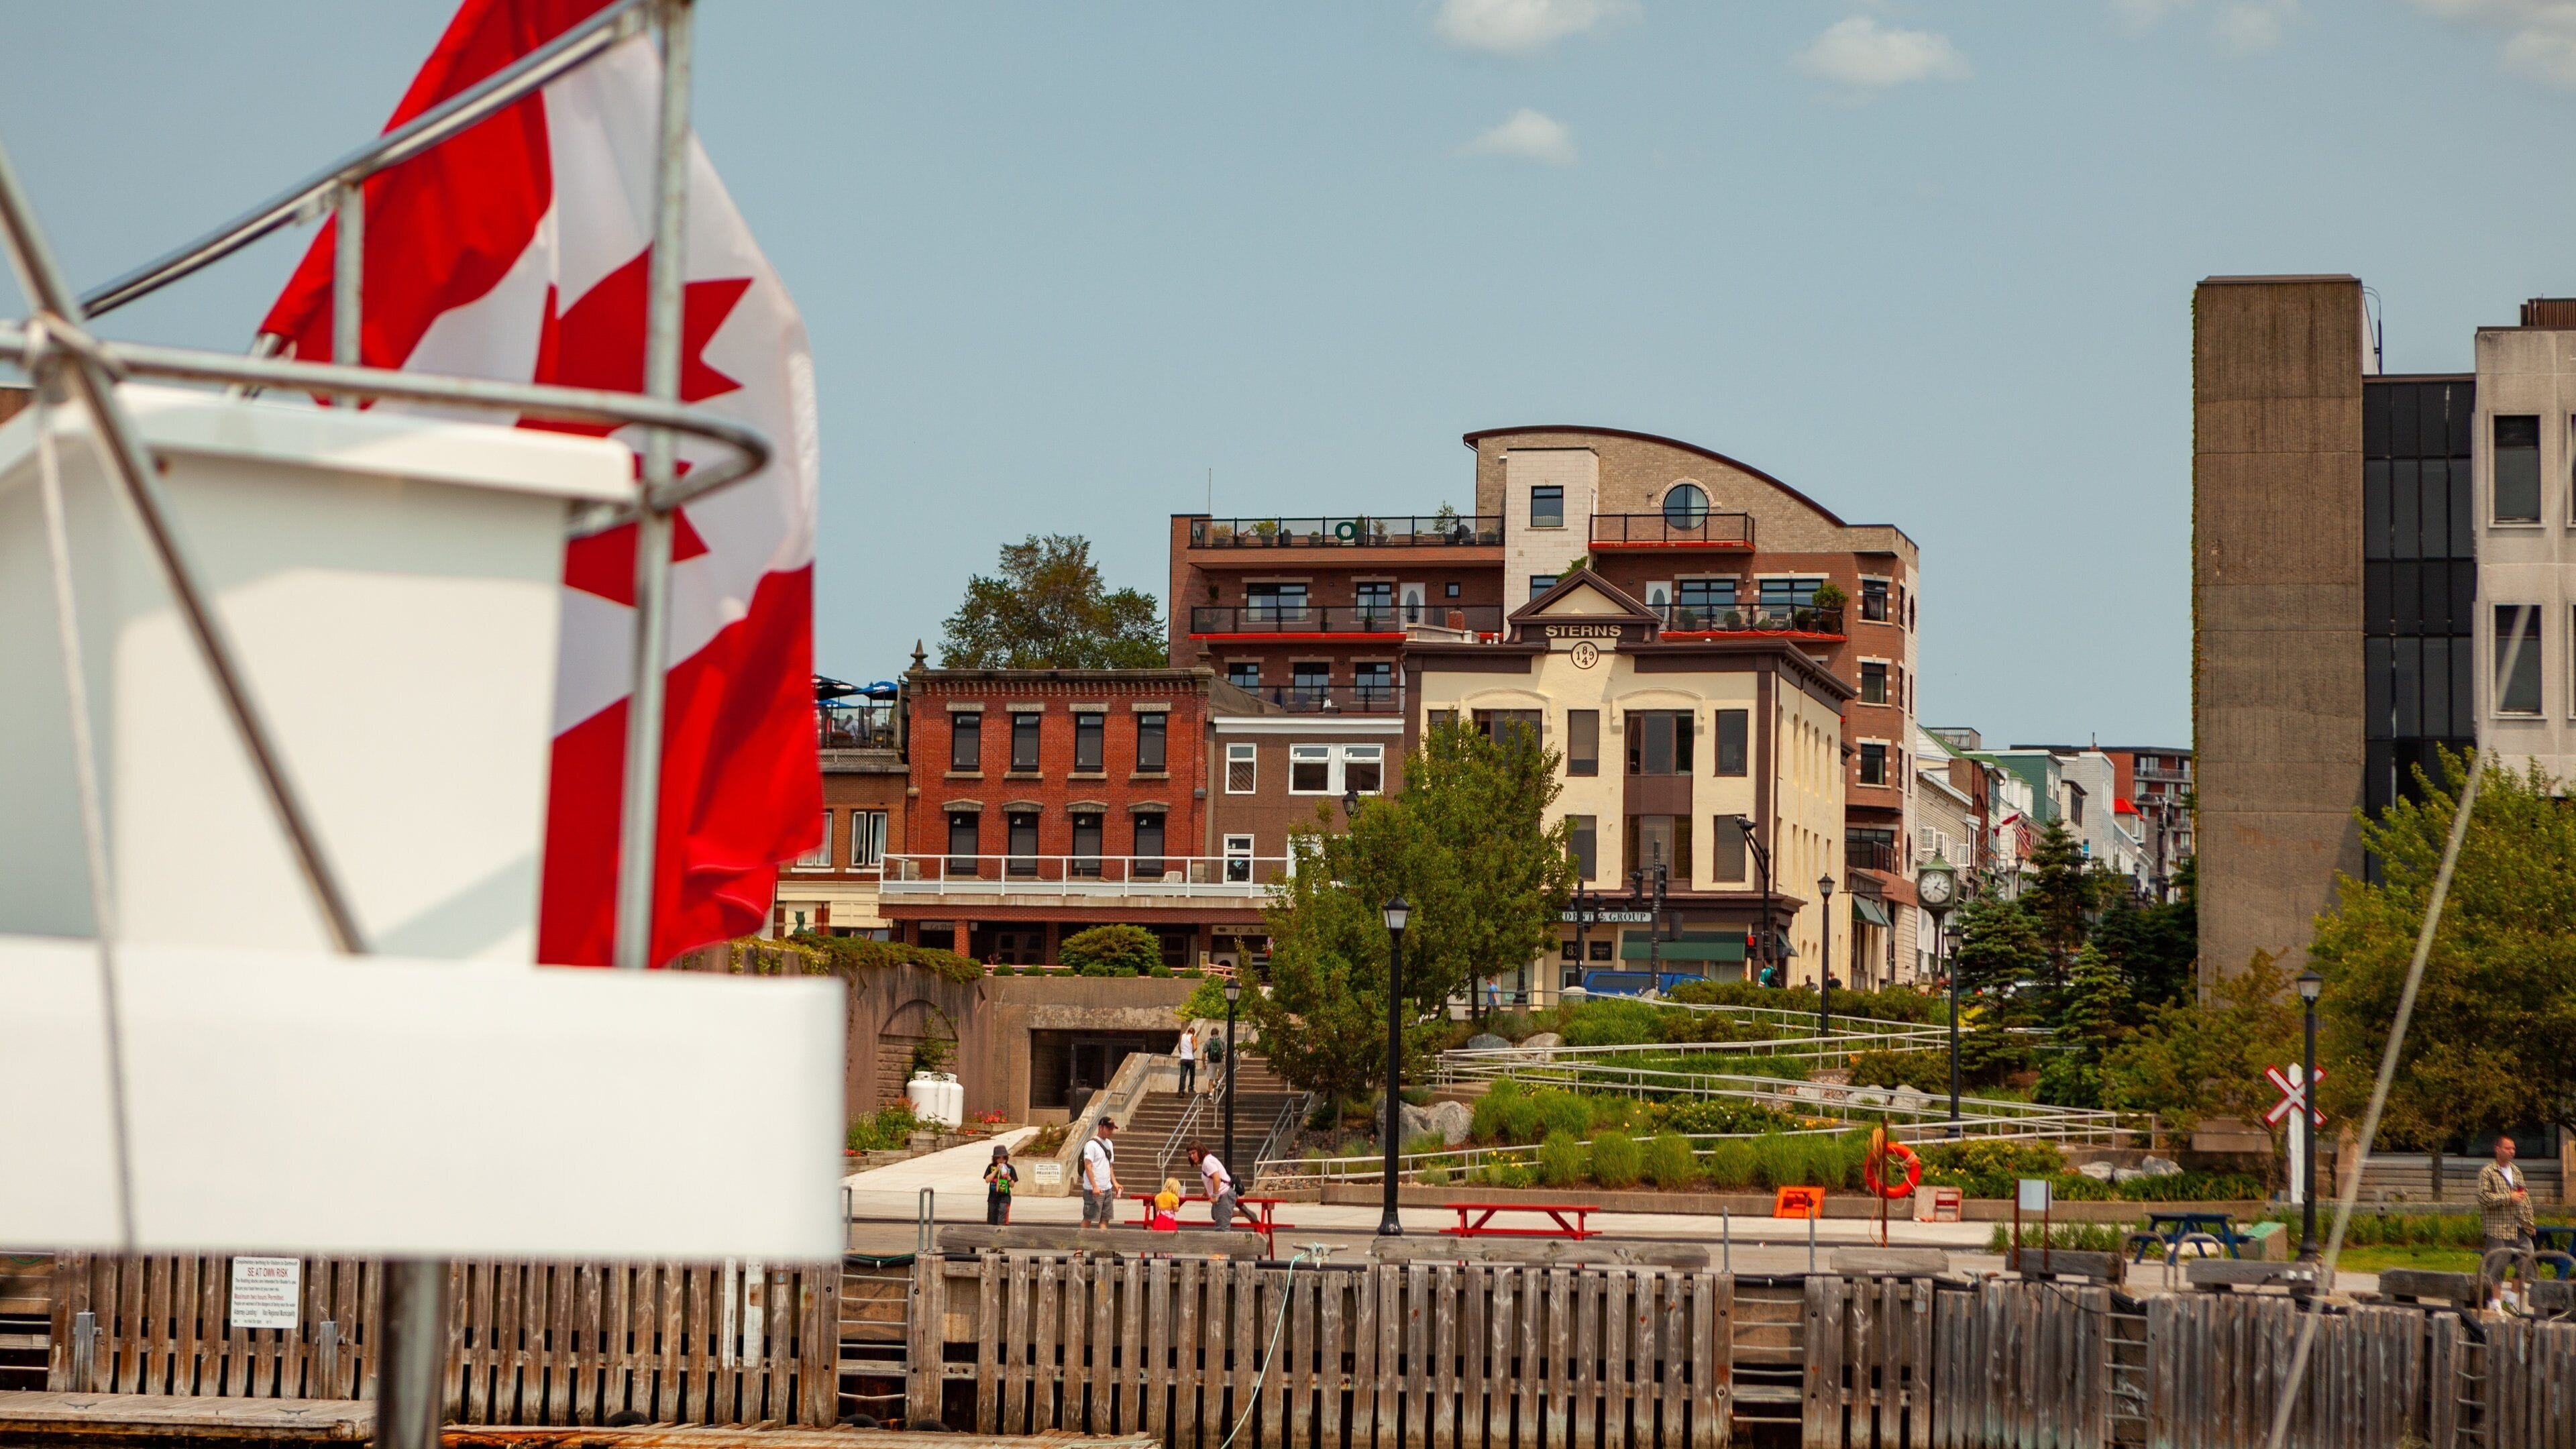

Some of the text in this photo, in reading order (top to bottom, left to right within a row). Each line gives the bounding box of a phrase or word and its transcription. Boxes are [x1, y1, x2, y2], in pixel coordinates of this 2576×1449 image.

[1545, 625, 1622, 637] STERNS
[1609, 912, 1646, 921] GROUP
[256, 1267, 262, 1277] AT
[264, 1268, 275, 1277] OWN
[276, 1268, 288, 1277] RISK
